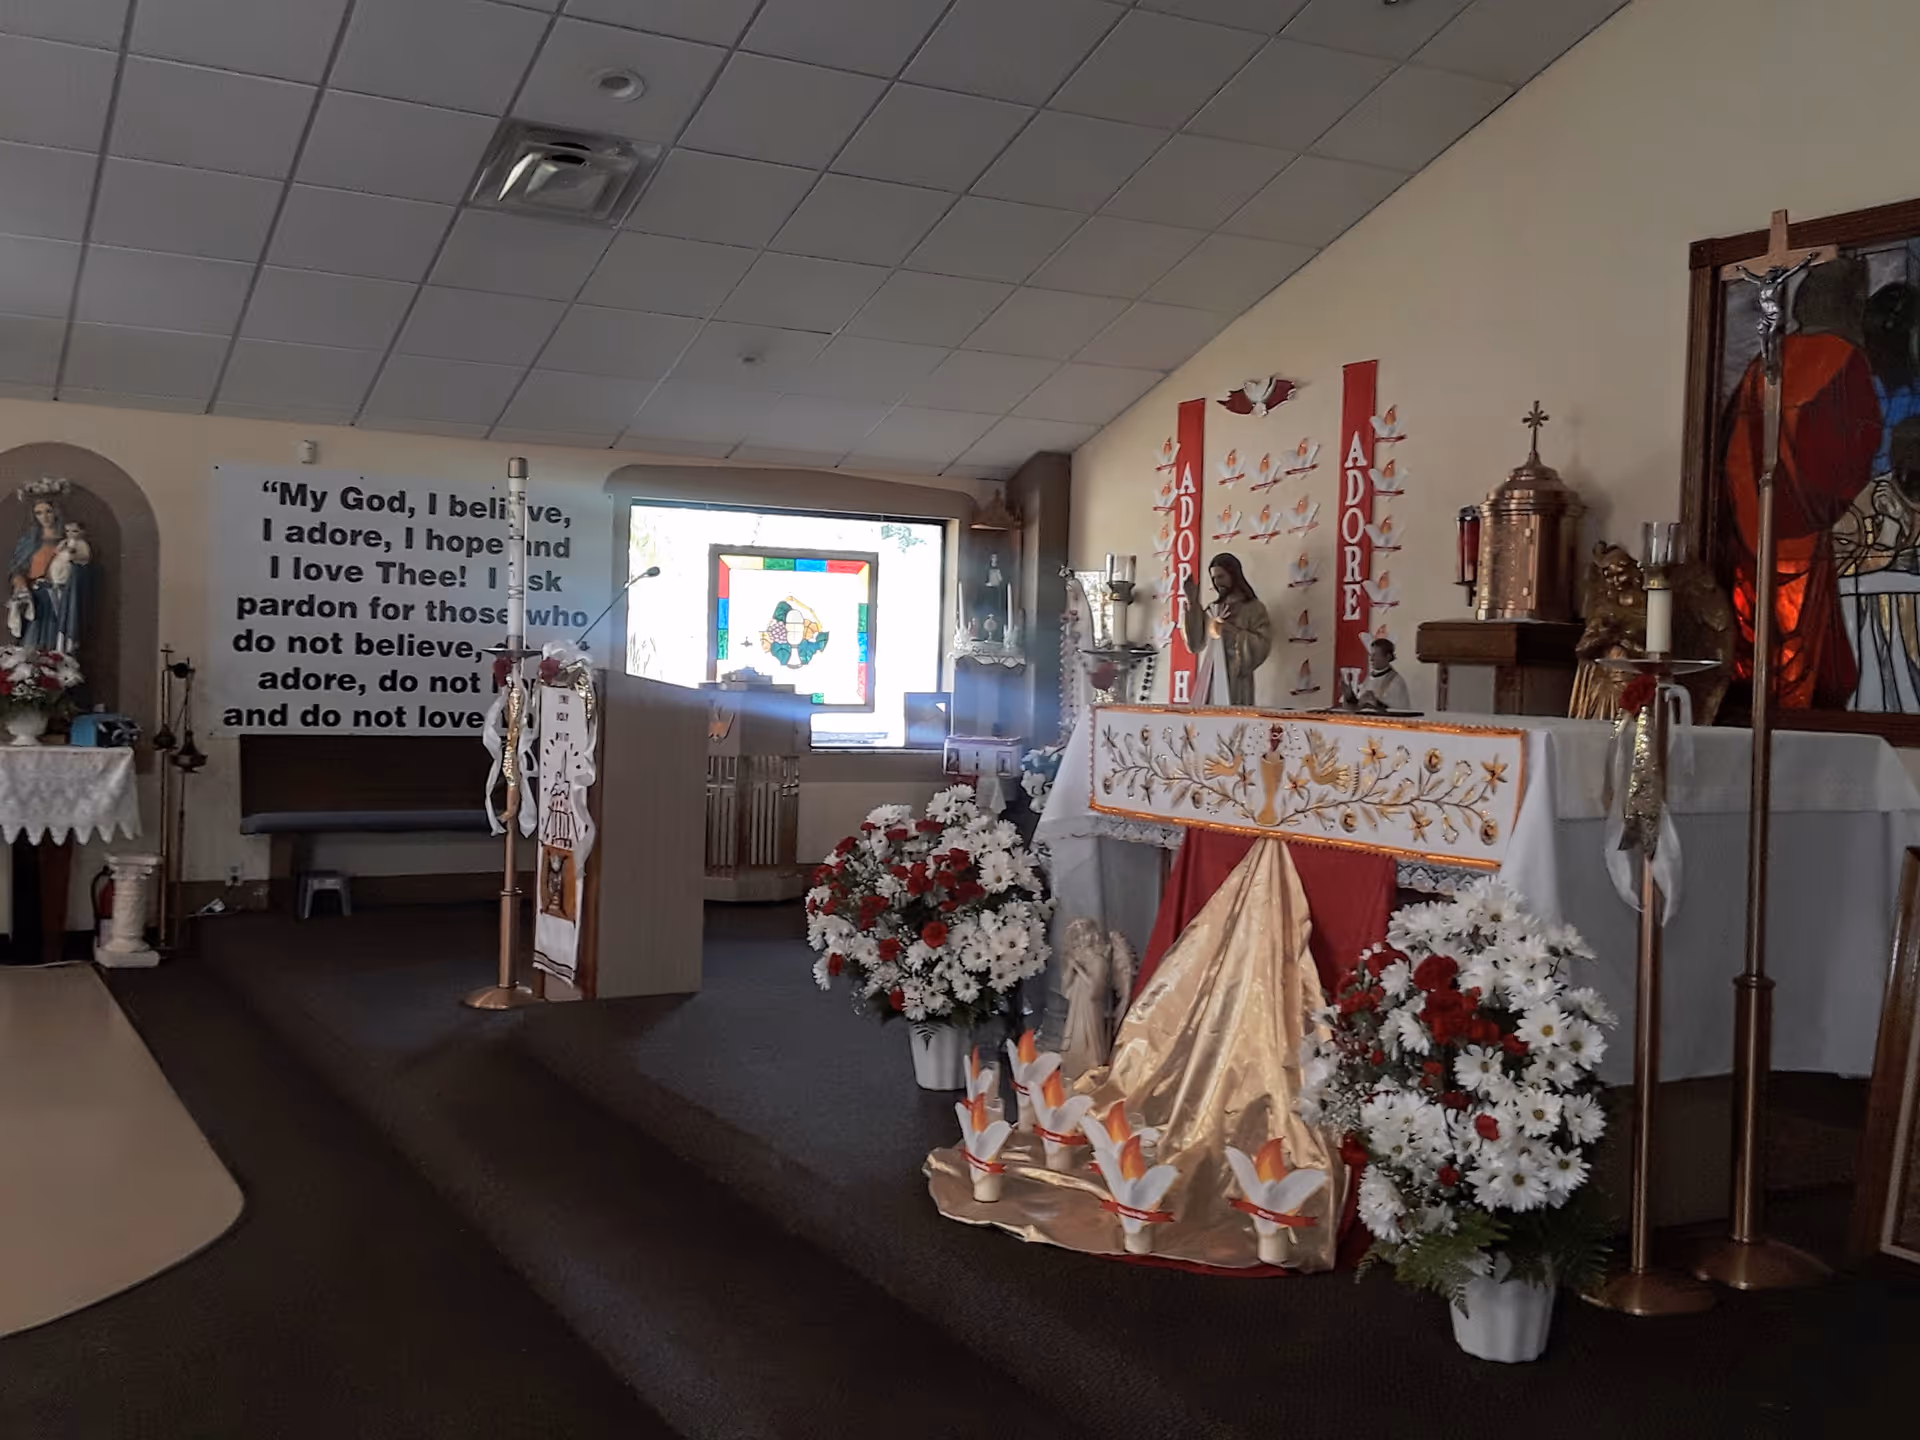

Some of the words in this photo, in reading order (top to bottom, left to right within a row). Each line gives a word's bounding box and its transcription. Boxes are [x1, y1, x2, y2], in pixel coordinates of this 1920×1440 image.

[262, 480, 328, 513] “My
[339, 486, 416, 519] God,
[428, 492, 437, 515] I
[449, 494, 571, 528] belive,
[263, 518, 272, 541] I
[284, 521, 392, 553] adore,
[405, 526, 413, 549] I
[426, 528, 504, 558] hope
[1341, 430, 1367, 621] ADORE
[270, 555, 279, 579] I
[293, 556, 364, 583] love
[375, 561, 467, 588] Thee!
[488, 567, 497, 590] I
[527, 570, 562, 592] sk
[237, 594, 358, 620] pardon
[368, 596, 415, 621] for
[425, 600, 508, 625] those
[526, 604, 588, 628] who
[232, 629, 275, 652] do
[287, 632, 343, 654] not
[355, 632, 482, 662] believe,
[258, 666, 366, 696] adore,
[378, 669, 418, 693] do
[430, 672, 481, 694] not
[223, 703, 288, 727] and
[300, 703, 341, 727] do
[353, 706, 407, 728] not
[418, 705, 485, 729] love
